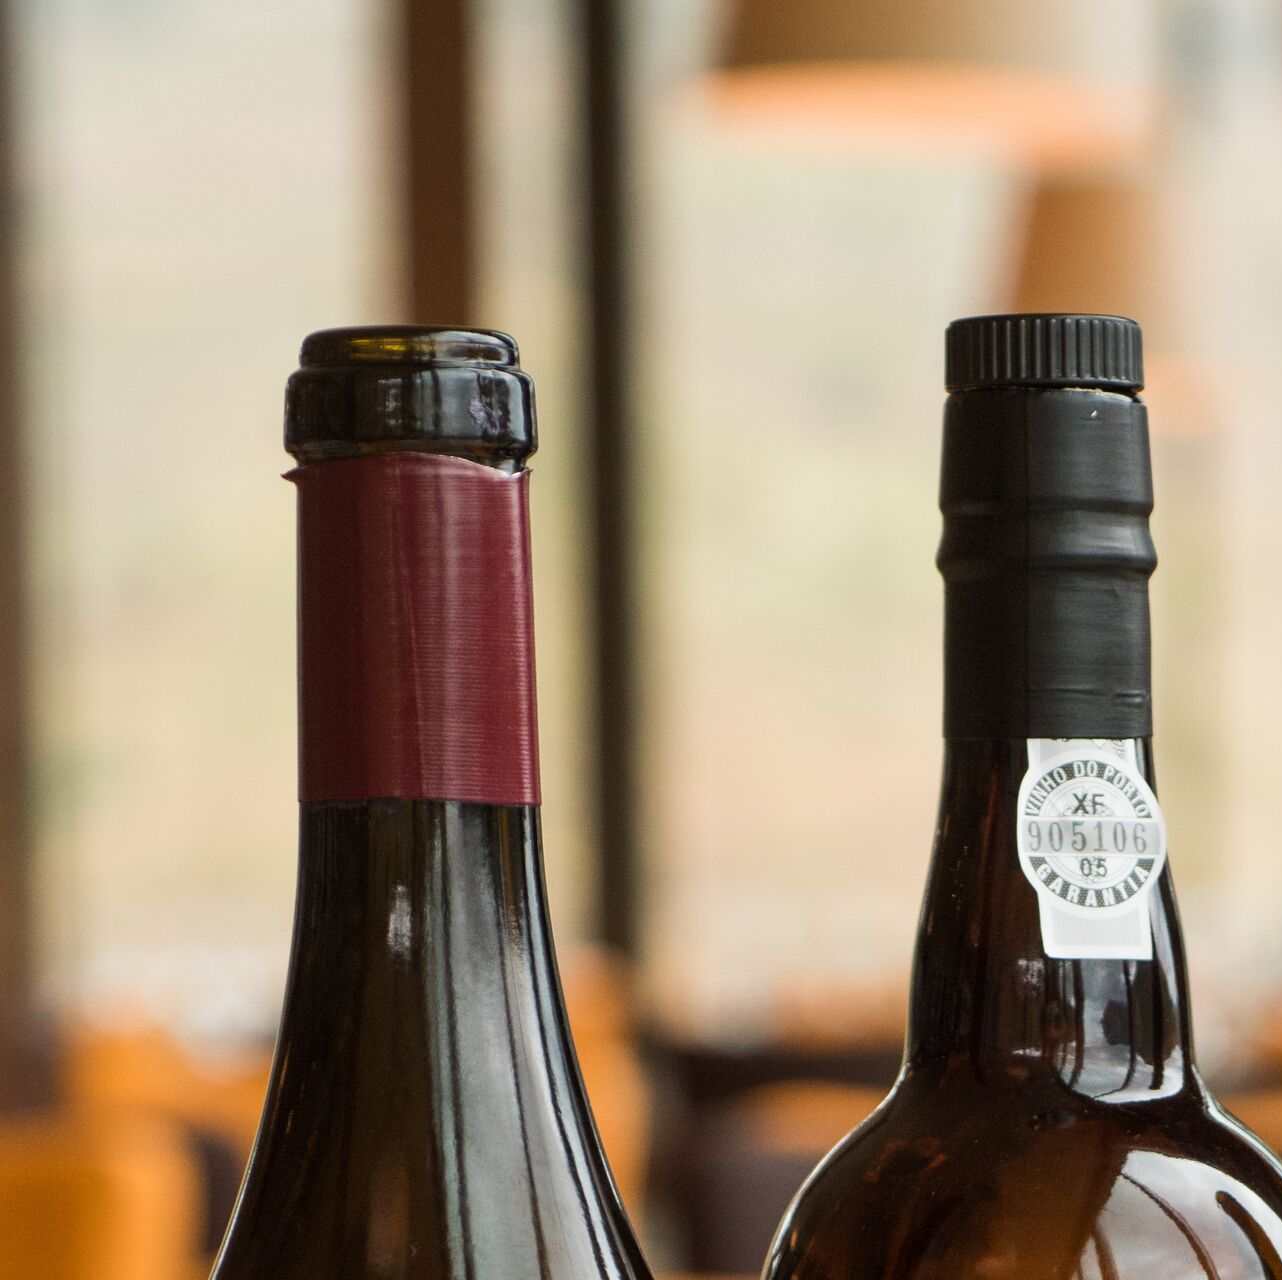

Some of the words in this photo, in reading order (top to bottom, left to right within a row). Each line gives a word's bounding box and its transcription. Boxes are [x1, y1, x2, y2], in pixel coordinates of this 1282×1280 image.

[1025, 767, 1067, 816] VINHO
[1073, 761, 1099, 778] DO
[1103, 766, 1149, 816] PORTO
[1072, 793, 1105, 815] XF
[1027, 821, 1147, 853] 905106
[1036, 864, 1151, 907] GARANTIA
